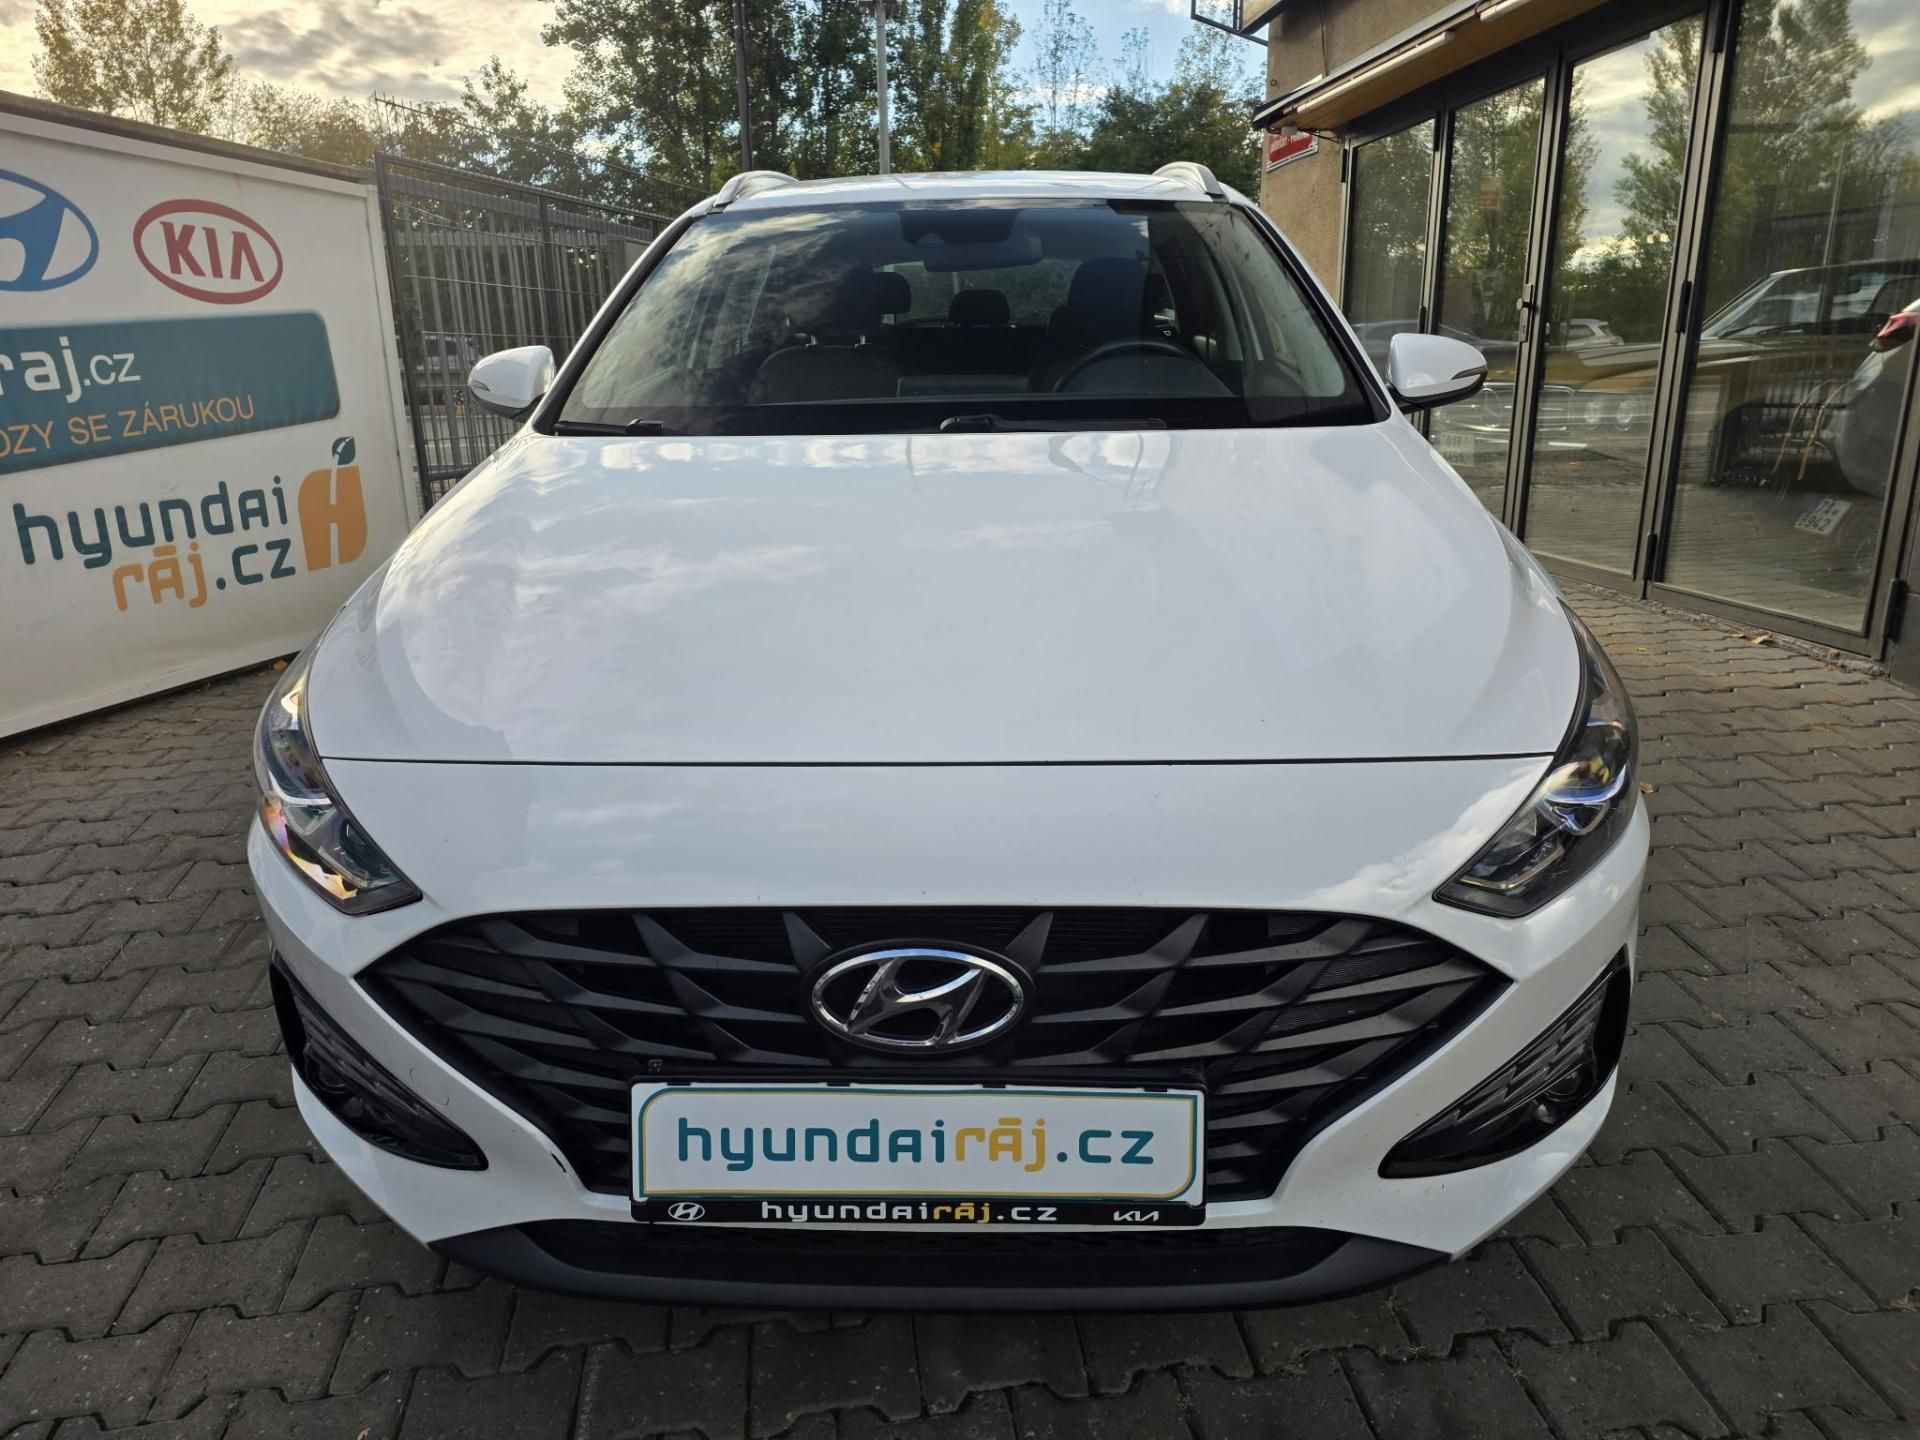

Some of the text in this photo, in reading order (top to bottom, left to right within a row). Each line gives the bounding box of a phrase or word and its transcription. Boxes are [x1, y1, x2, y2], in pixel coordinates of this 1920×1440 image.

[160, 221, 264, 282] KIA
[68, 414, 112, 446] SE
[118, 395, 256, 437] ZÁRUKOU
[12, 475, 288, 570] hyundai
